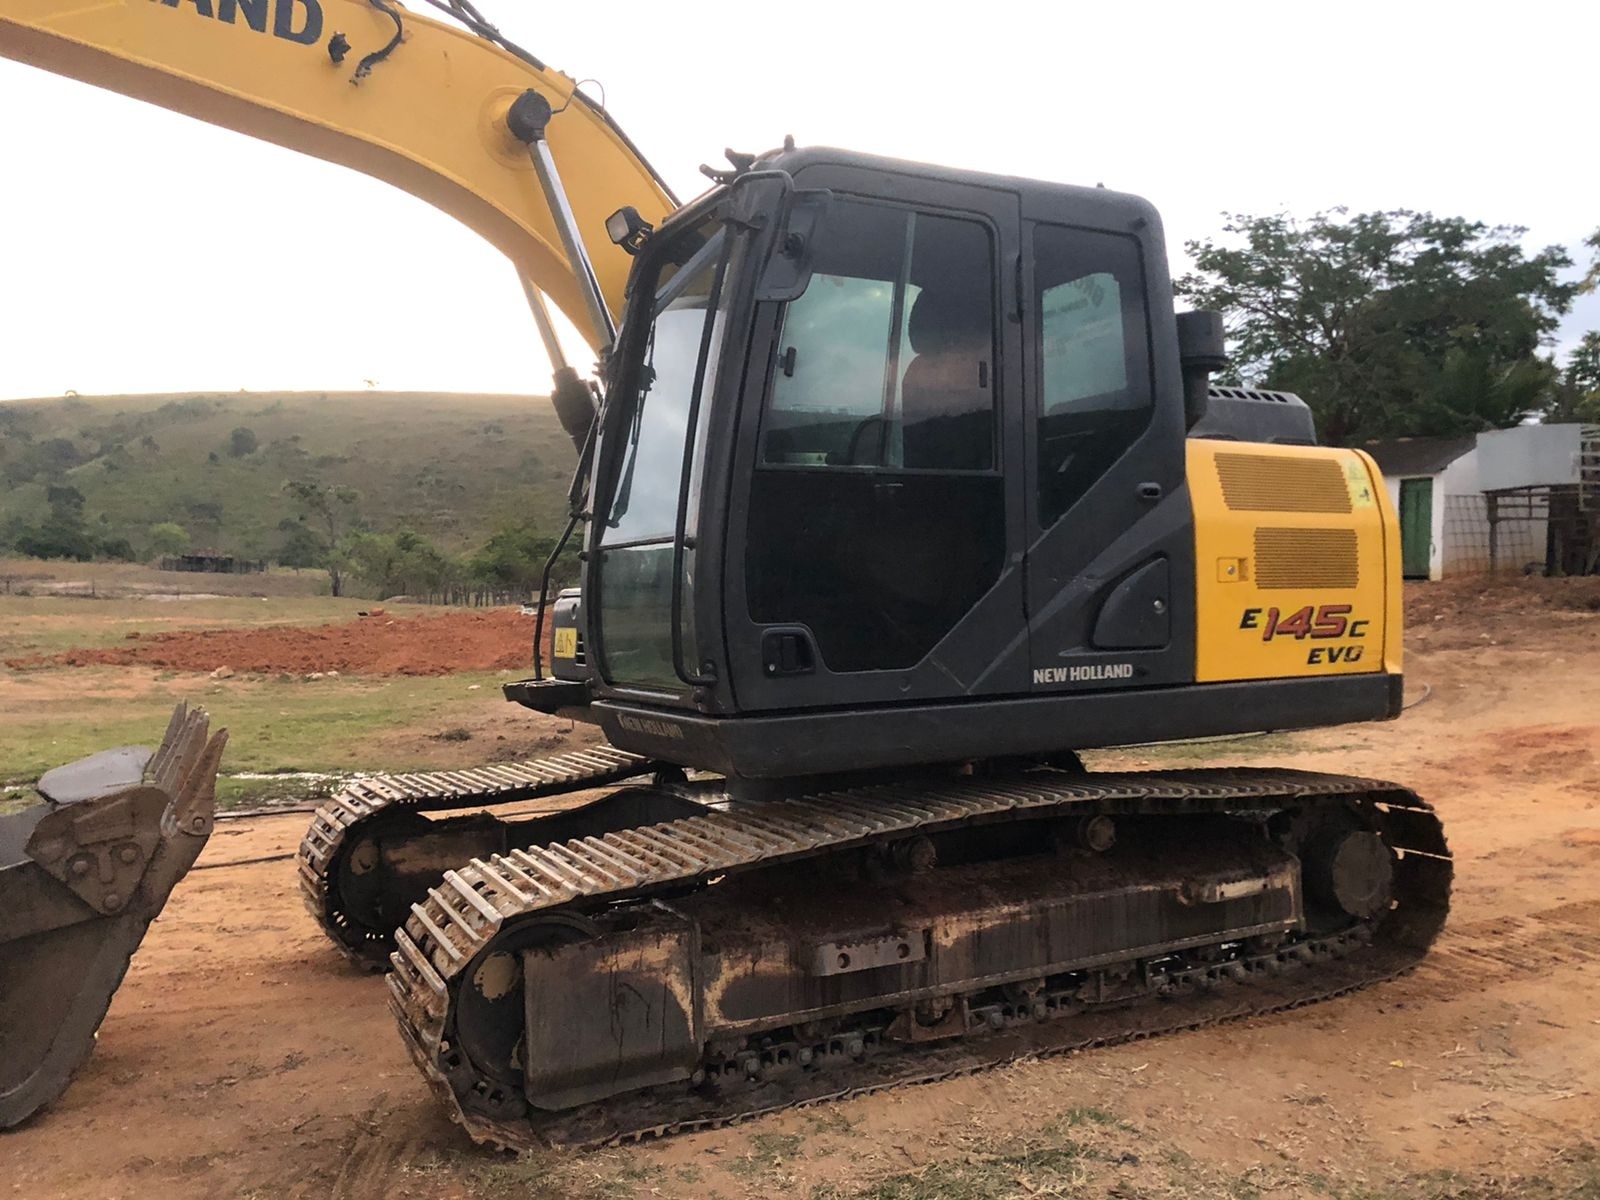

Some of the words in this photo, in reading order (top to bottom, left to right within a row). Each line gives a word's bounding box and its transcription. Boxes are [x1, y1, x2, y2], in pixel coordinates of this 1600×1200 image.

[1306, 645, 1365, 666] EVO
[1033, 667, 1067, 684] NEW
[1070, 664, 1134, 681] HOLLAND
